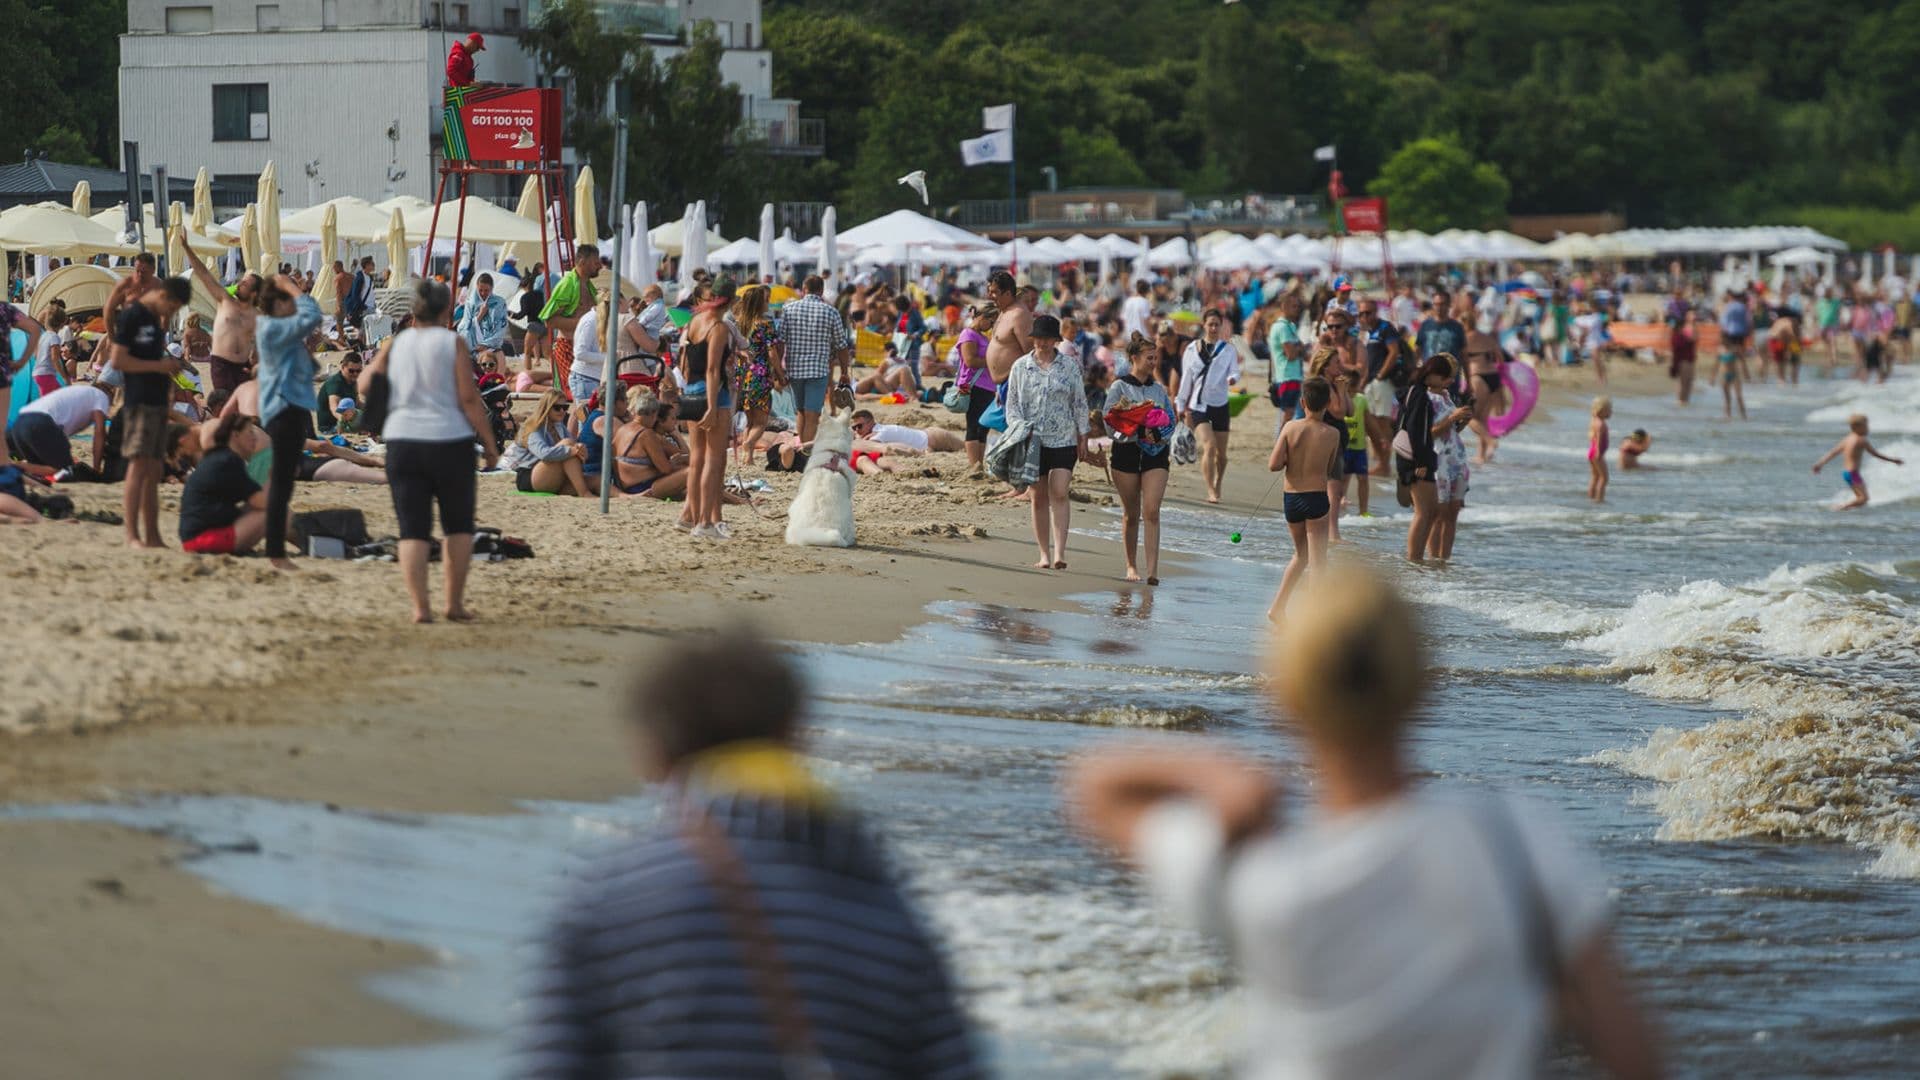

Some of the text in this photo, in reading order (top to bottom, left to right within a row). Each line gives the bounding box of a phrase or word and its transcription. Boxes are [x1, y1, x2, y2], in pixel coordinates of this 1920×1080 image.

[472, 116, 533, 126] 601 100 100
